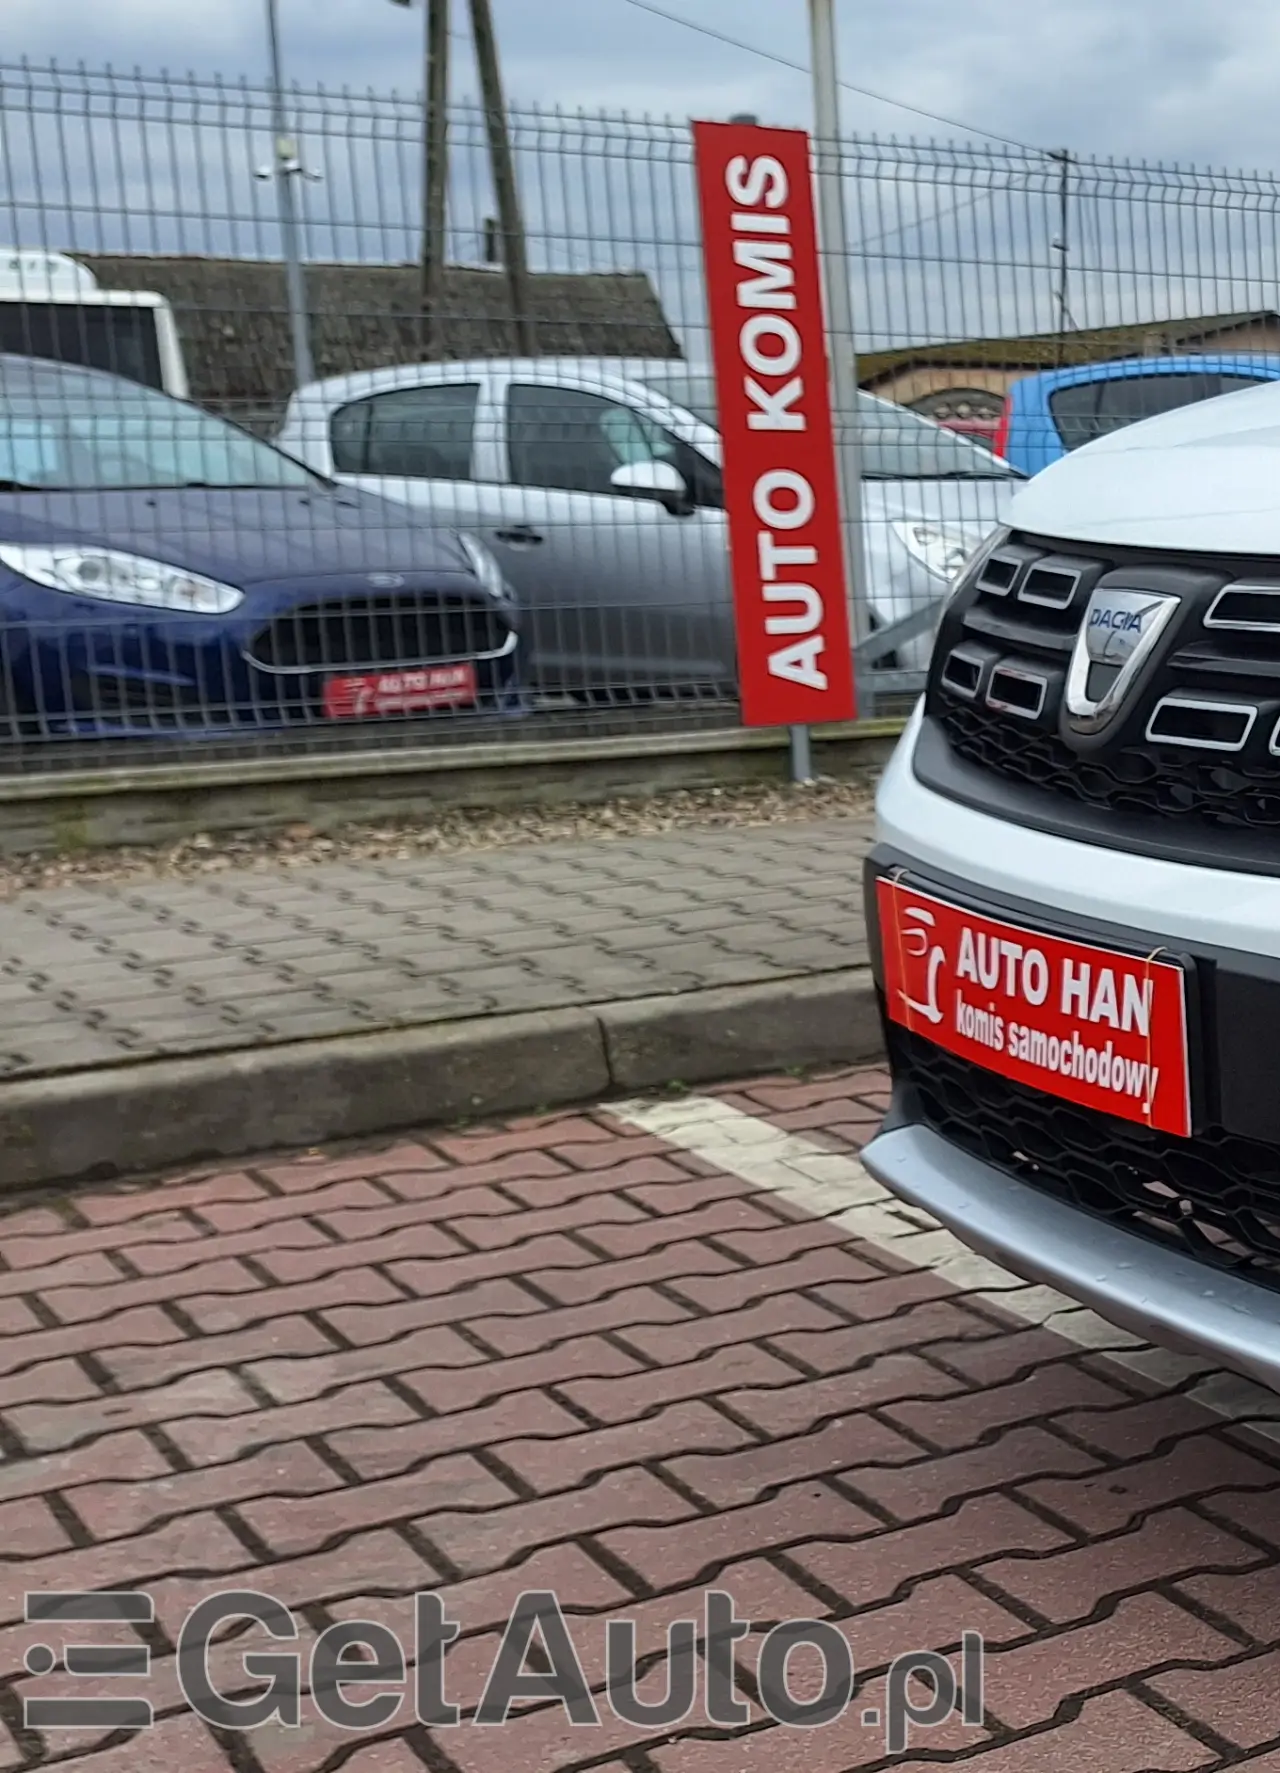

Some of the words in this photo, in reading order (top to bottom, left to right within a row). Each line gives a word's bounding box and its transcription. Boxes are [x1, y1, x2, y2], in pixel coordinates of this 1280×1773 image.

[725, 153, 807, 432] KOMIS
[753, 467, 829, 691] AUTO
[1088, 608, 1142, 634] DACIA
[956, 927, 1049, 1006] AUTO
[1061, 957, 1154, 1037] HAN
[955, 988, 1005, 1052] komis
[1007, 1020, 1160, 1115] samochodowy
